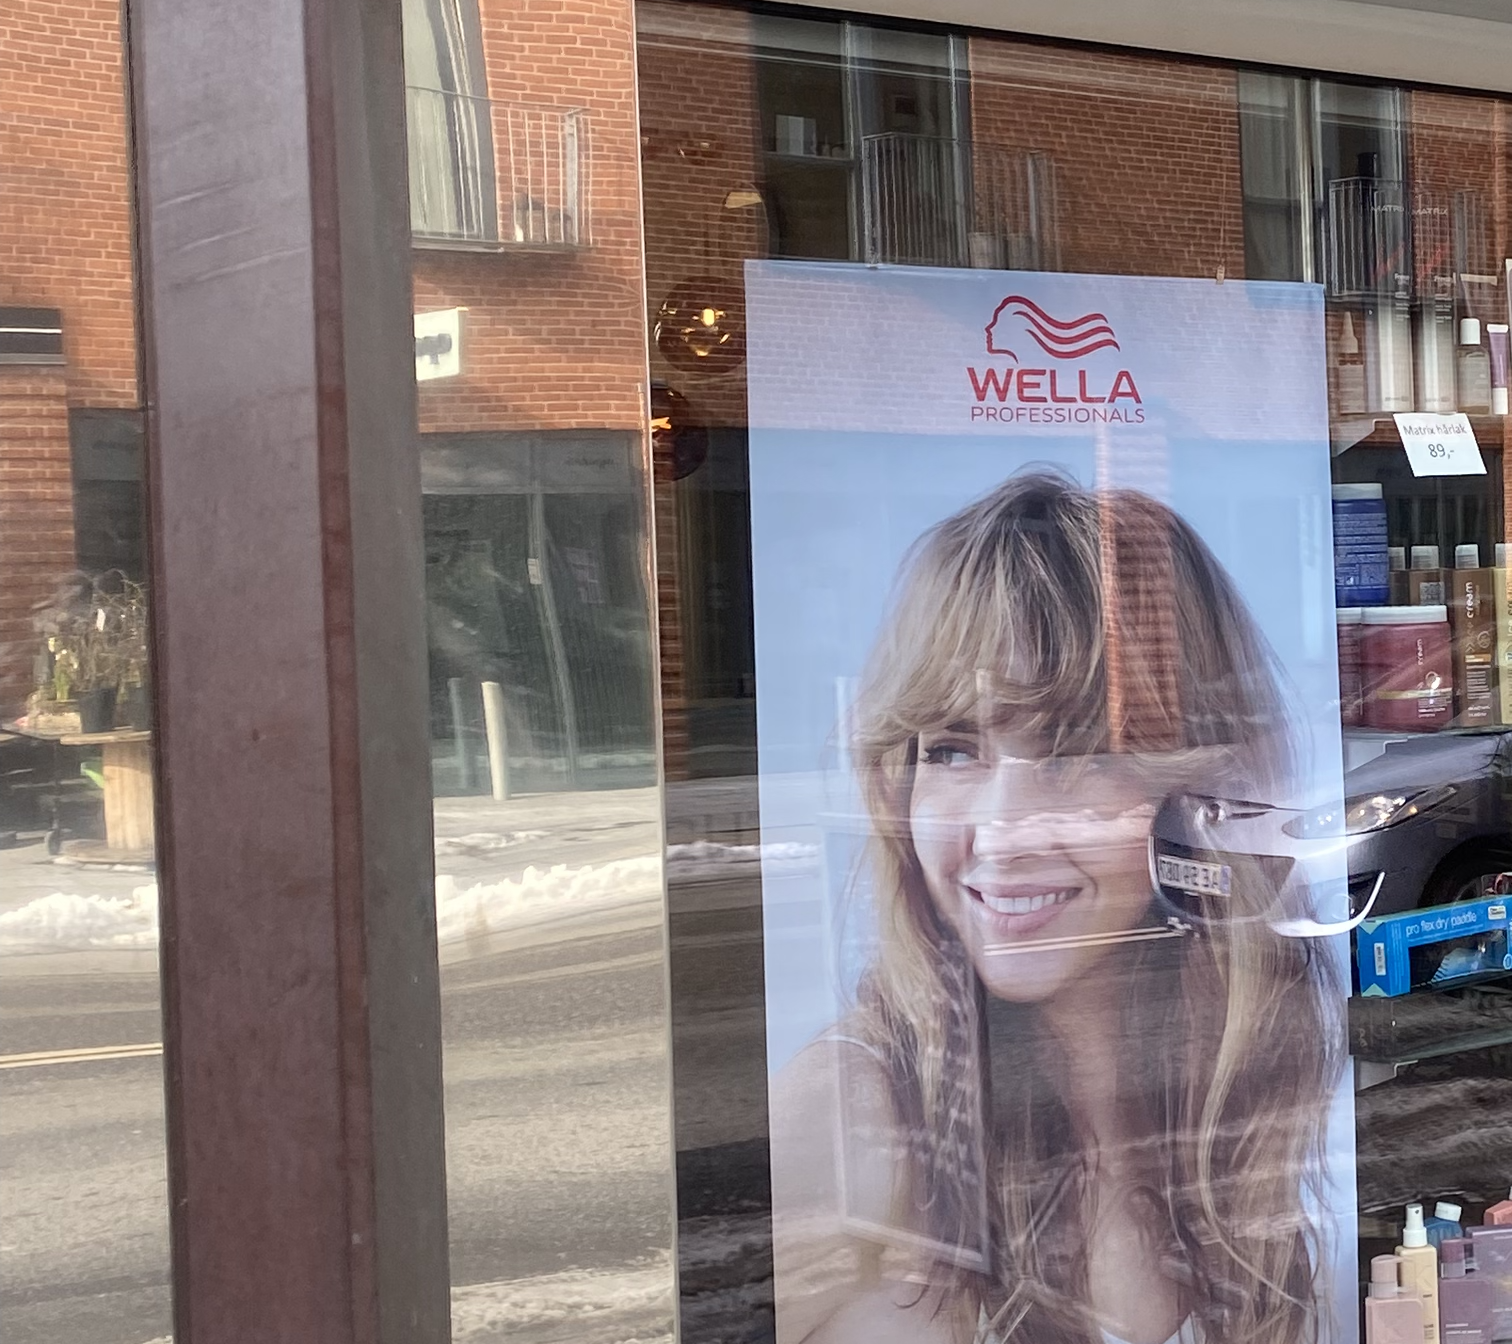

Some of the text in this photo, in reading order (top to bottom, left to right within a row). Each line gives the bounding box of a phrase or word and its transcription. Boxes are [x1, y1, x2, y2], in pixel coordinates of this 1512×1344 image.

[966, 366, 1144, 405] WELLA
[970, 405, 1146, 424] PROFESSIONALS
[1402, 422, 1468, 436] Matrix hårlak
[1427, 443, 1455, 460] 89,-
[1405, 925, 1421, 938] pro
[1420, 919, 1436, 933] flex
[1435, 917, 1450, 931] dry
[1451, 911, 1477, 927] paddle
